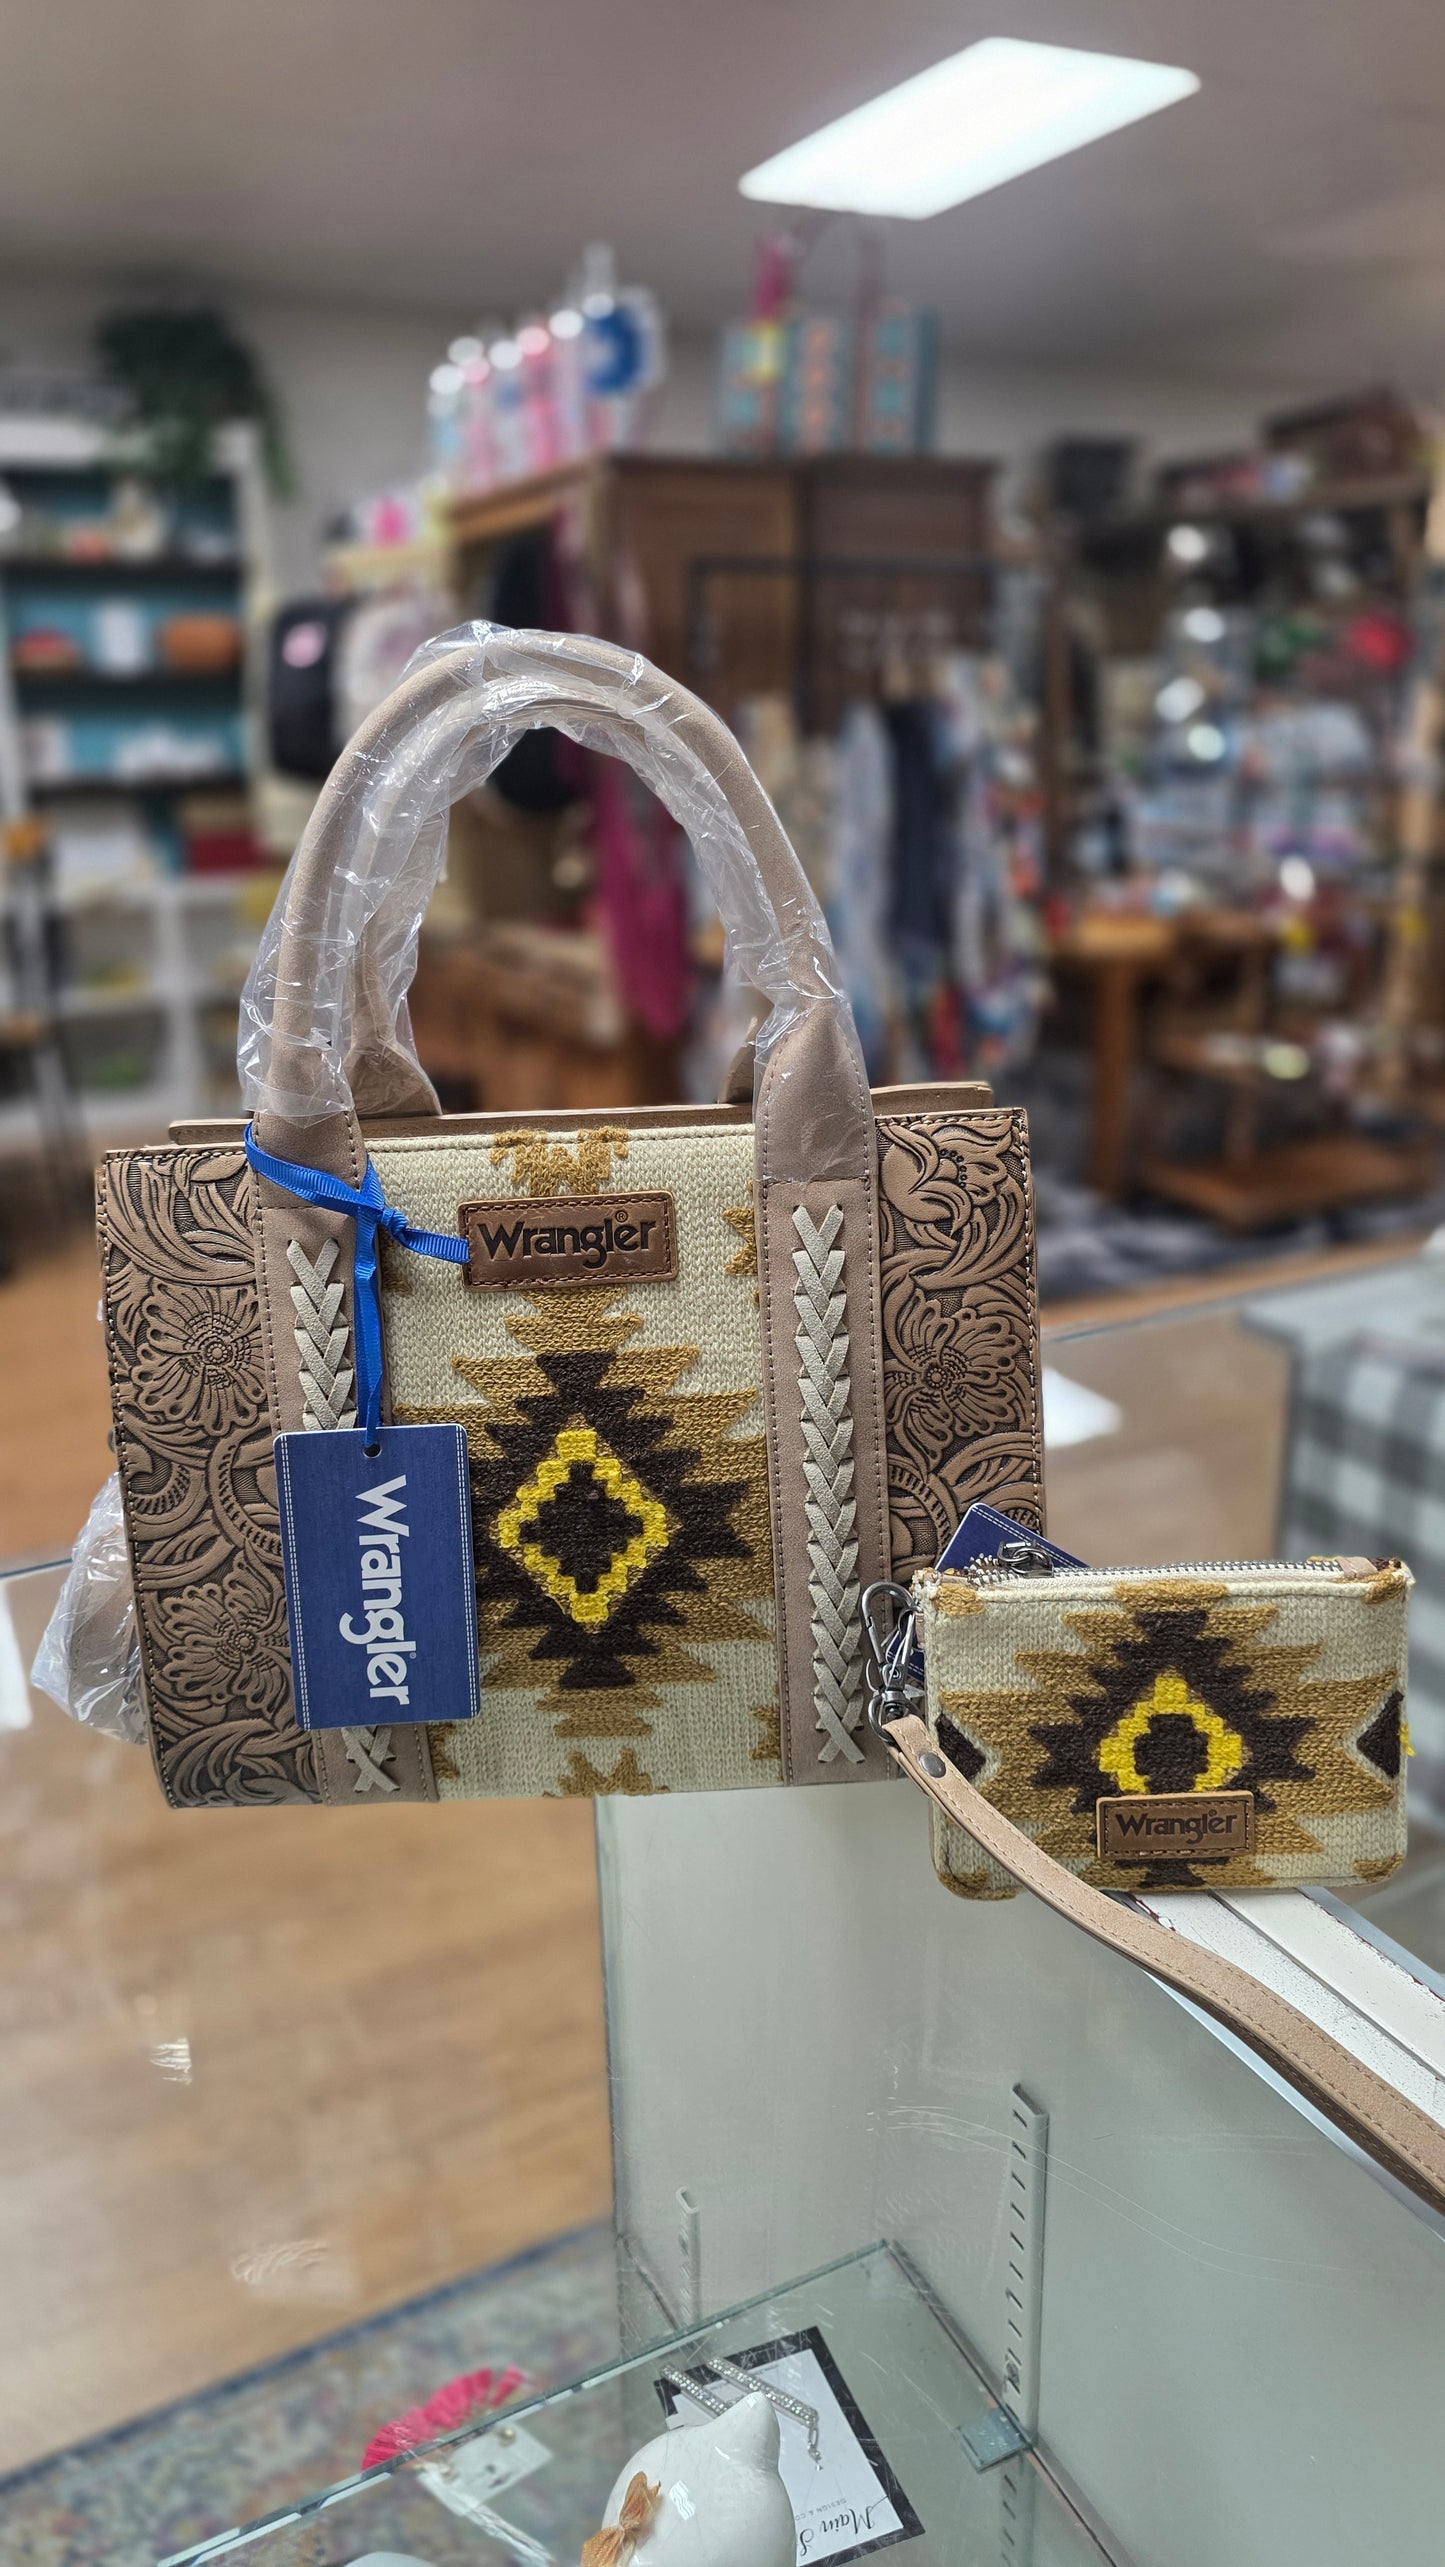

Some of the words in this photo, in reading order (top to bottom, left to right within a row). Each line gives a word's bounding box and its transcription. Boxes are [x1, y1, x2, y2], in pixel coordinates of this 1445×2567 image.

[477, 1217, 657, 1269] Wrangler
[338, 1474, 417, 1705] Wrangler
[1115, 1811, 1238, 1845] Wrangler
[816, 2498, 847, 2512] DESIGN
[820, 2496, 888, 2535] Main
